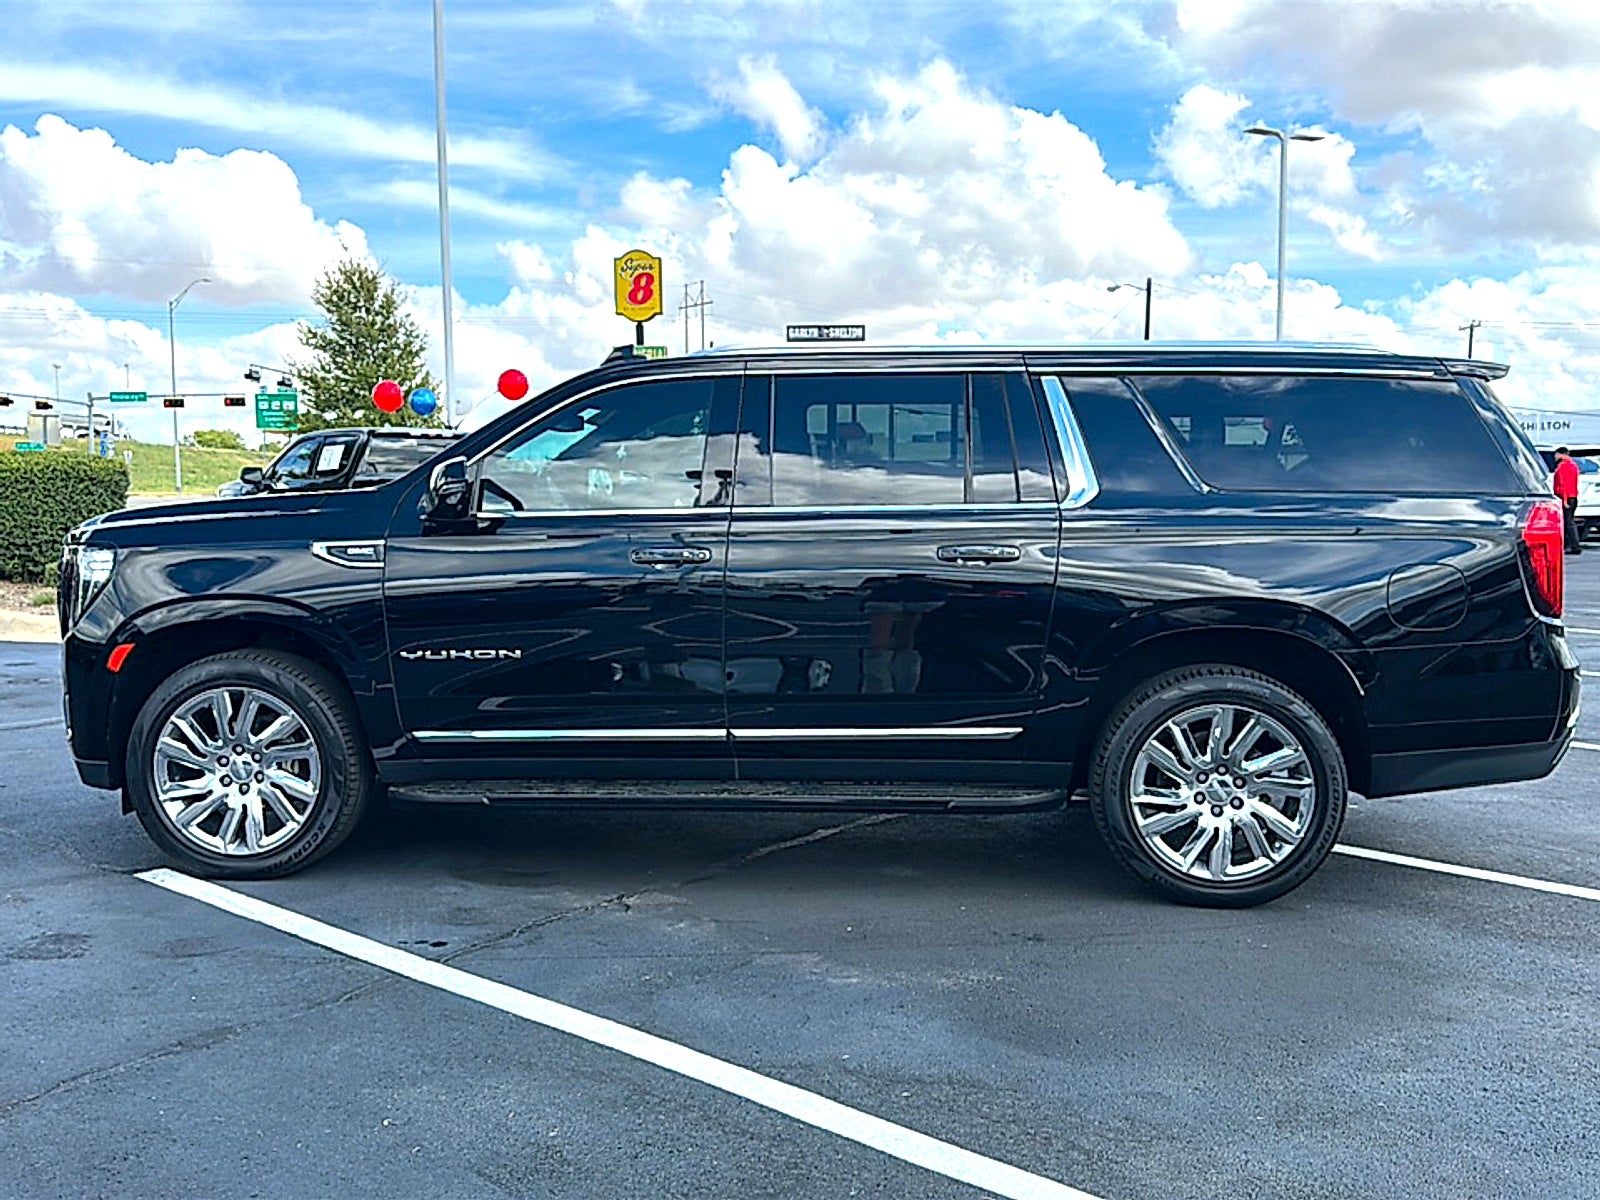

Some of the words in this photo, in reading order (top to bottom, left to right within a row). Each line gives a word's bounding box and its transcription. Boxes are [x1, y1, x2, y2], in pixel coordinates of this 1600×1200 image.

[620, 258, 655, 279] Super
[627, 272, 655, 305] 8
[1519, 421, 1571, 431] SHLTON
[399, 649, 522, 660] YUKON
